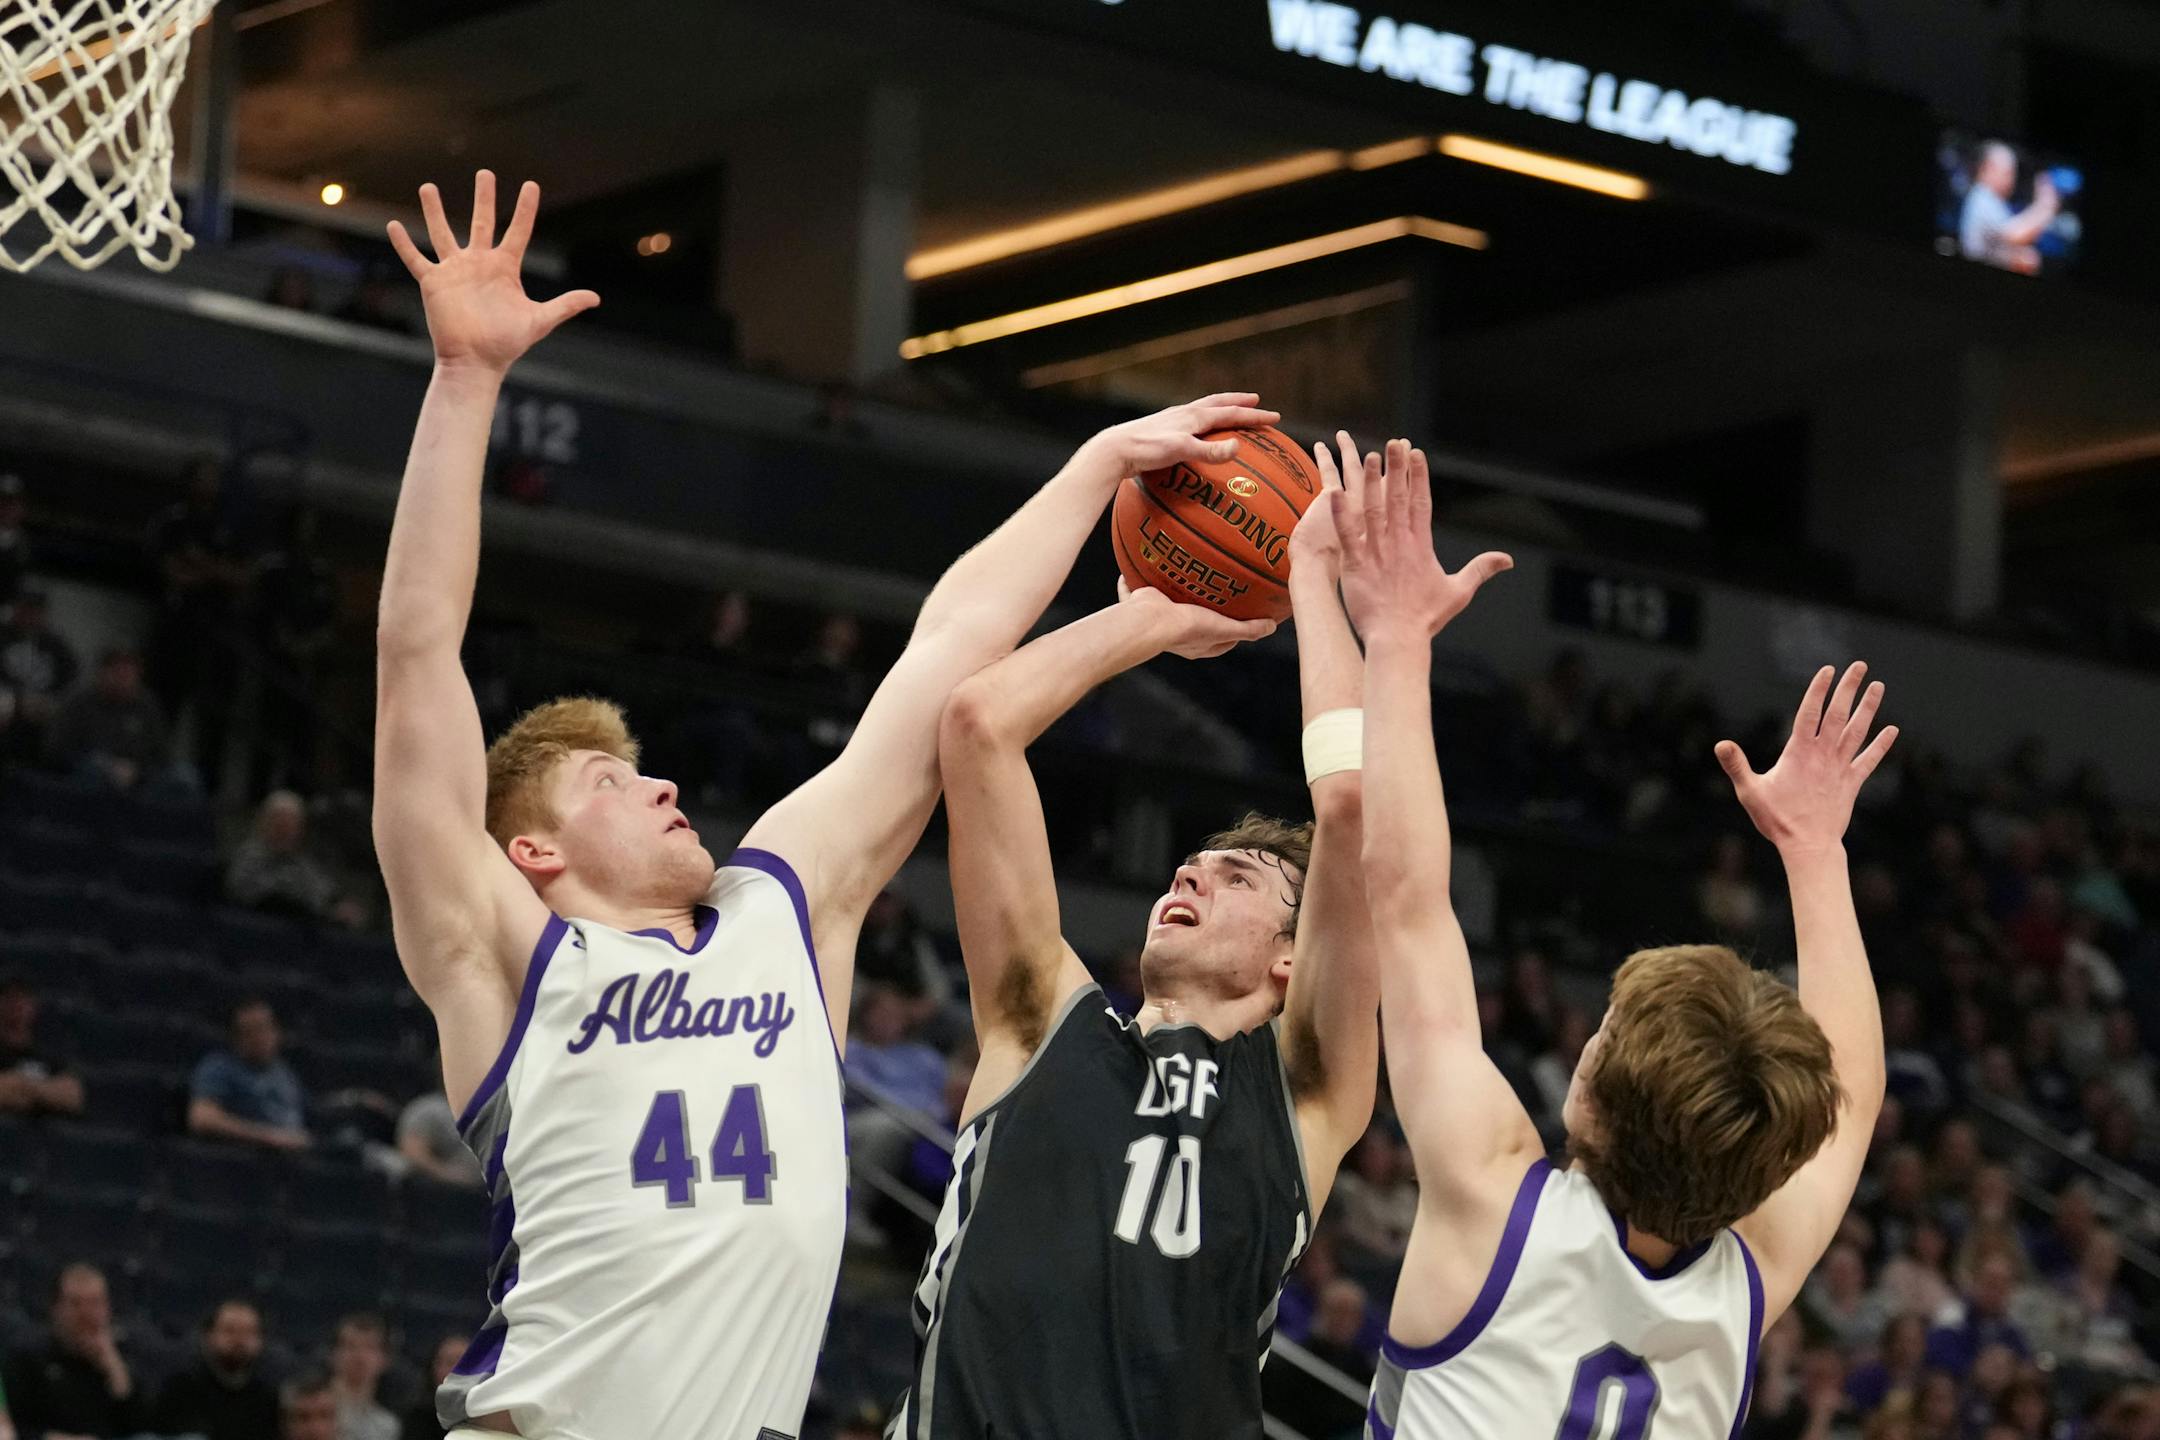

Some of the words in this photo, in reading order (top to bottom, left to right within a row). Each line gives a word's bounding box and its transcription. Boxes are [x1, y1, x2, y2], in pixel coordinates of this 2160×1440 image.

[1268, 0, 1360, 67] WE
[1358, 16, 1475, 96] ARE
[1481, 44, 1590, 124] THE
[1585, 72, 1798, 175] LEAGUE
[1139, 516, 1251, 598] LEGACY
[1159, 461, 1290, 569] SPALDING
[567, 968, 795, 1058] Albany
[630, 1083, 777, 1209] 44
[1113, 1133, 1201, 1259] 10
